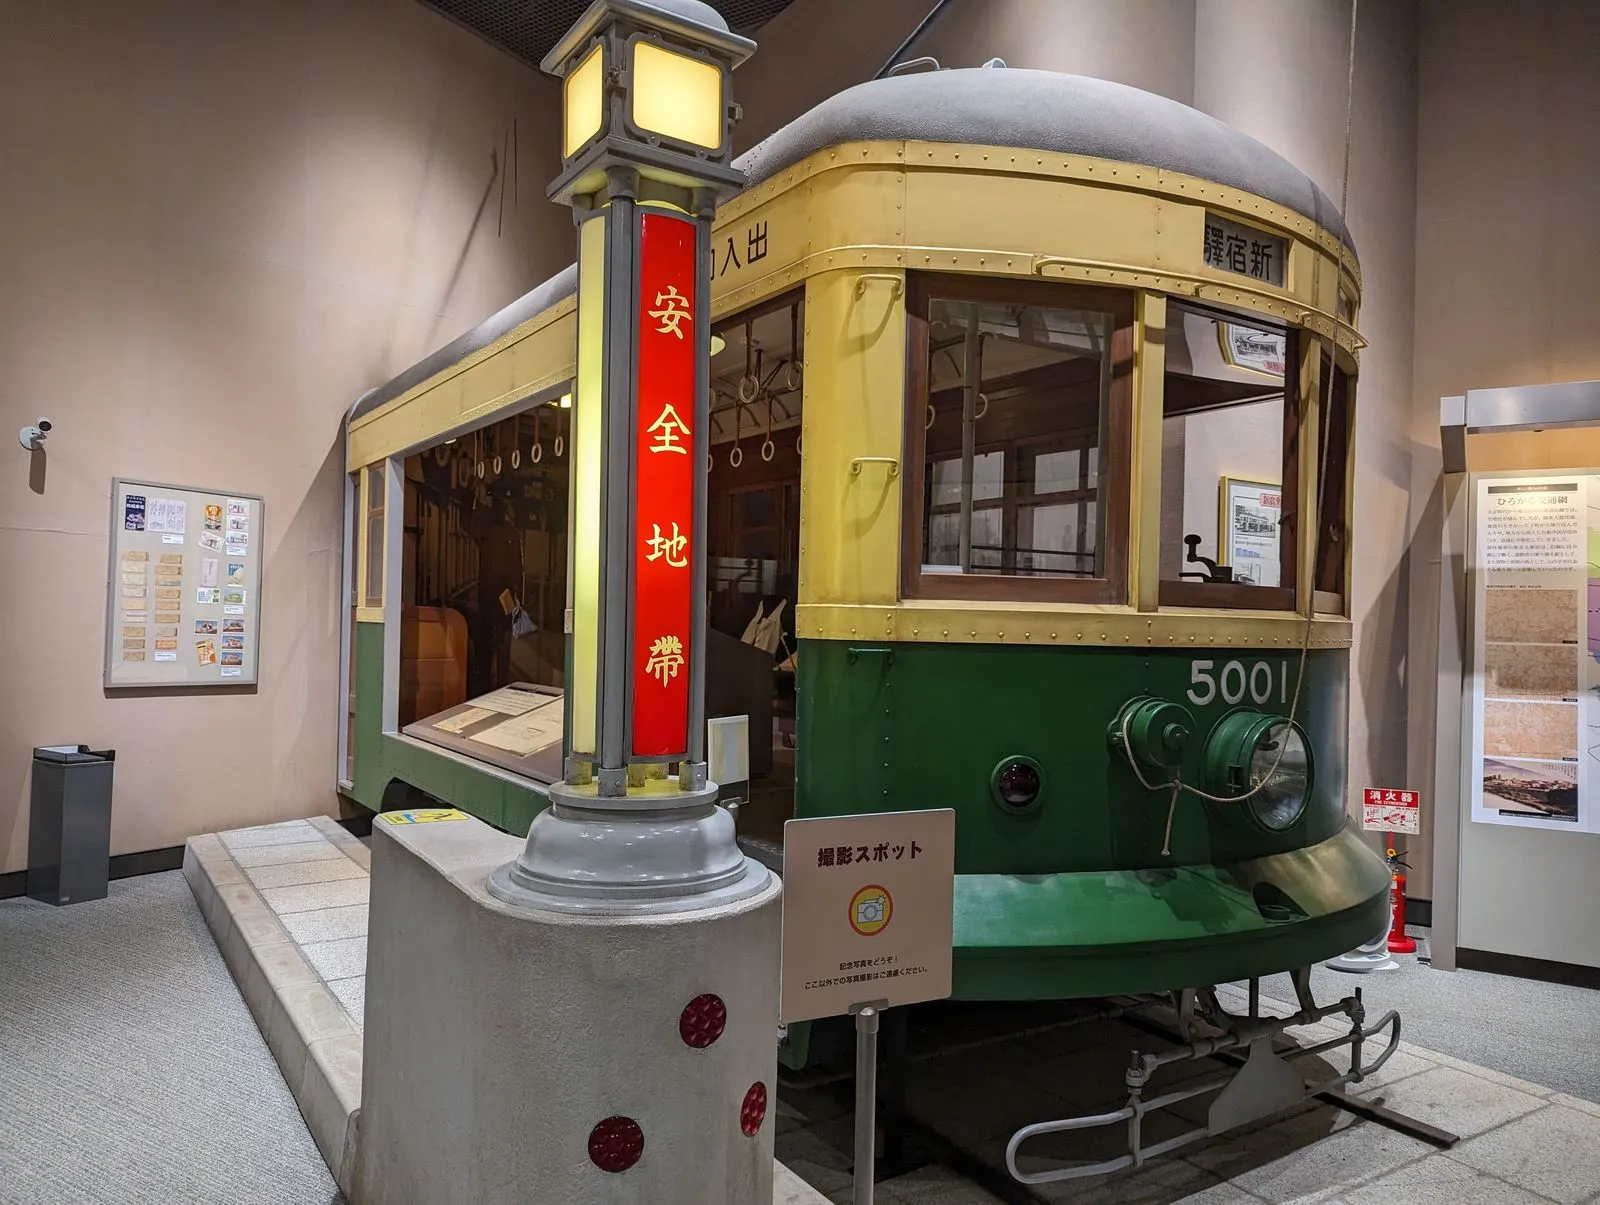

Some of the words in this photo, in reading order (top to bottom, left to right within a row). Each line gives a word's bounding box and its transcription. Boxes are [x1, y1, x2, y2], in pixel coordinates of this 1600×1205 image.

[1186, 659, 1288, 706] 5001
[1369, 790, 1413, 803] 消火器
[817, 841, 923, 868] 撮影スポット
[804, 966, 928, 990] ここ以外での写真撮影はご遠慮ください。
